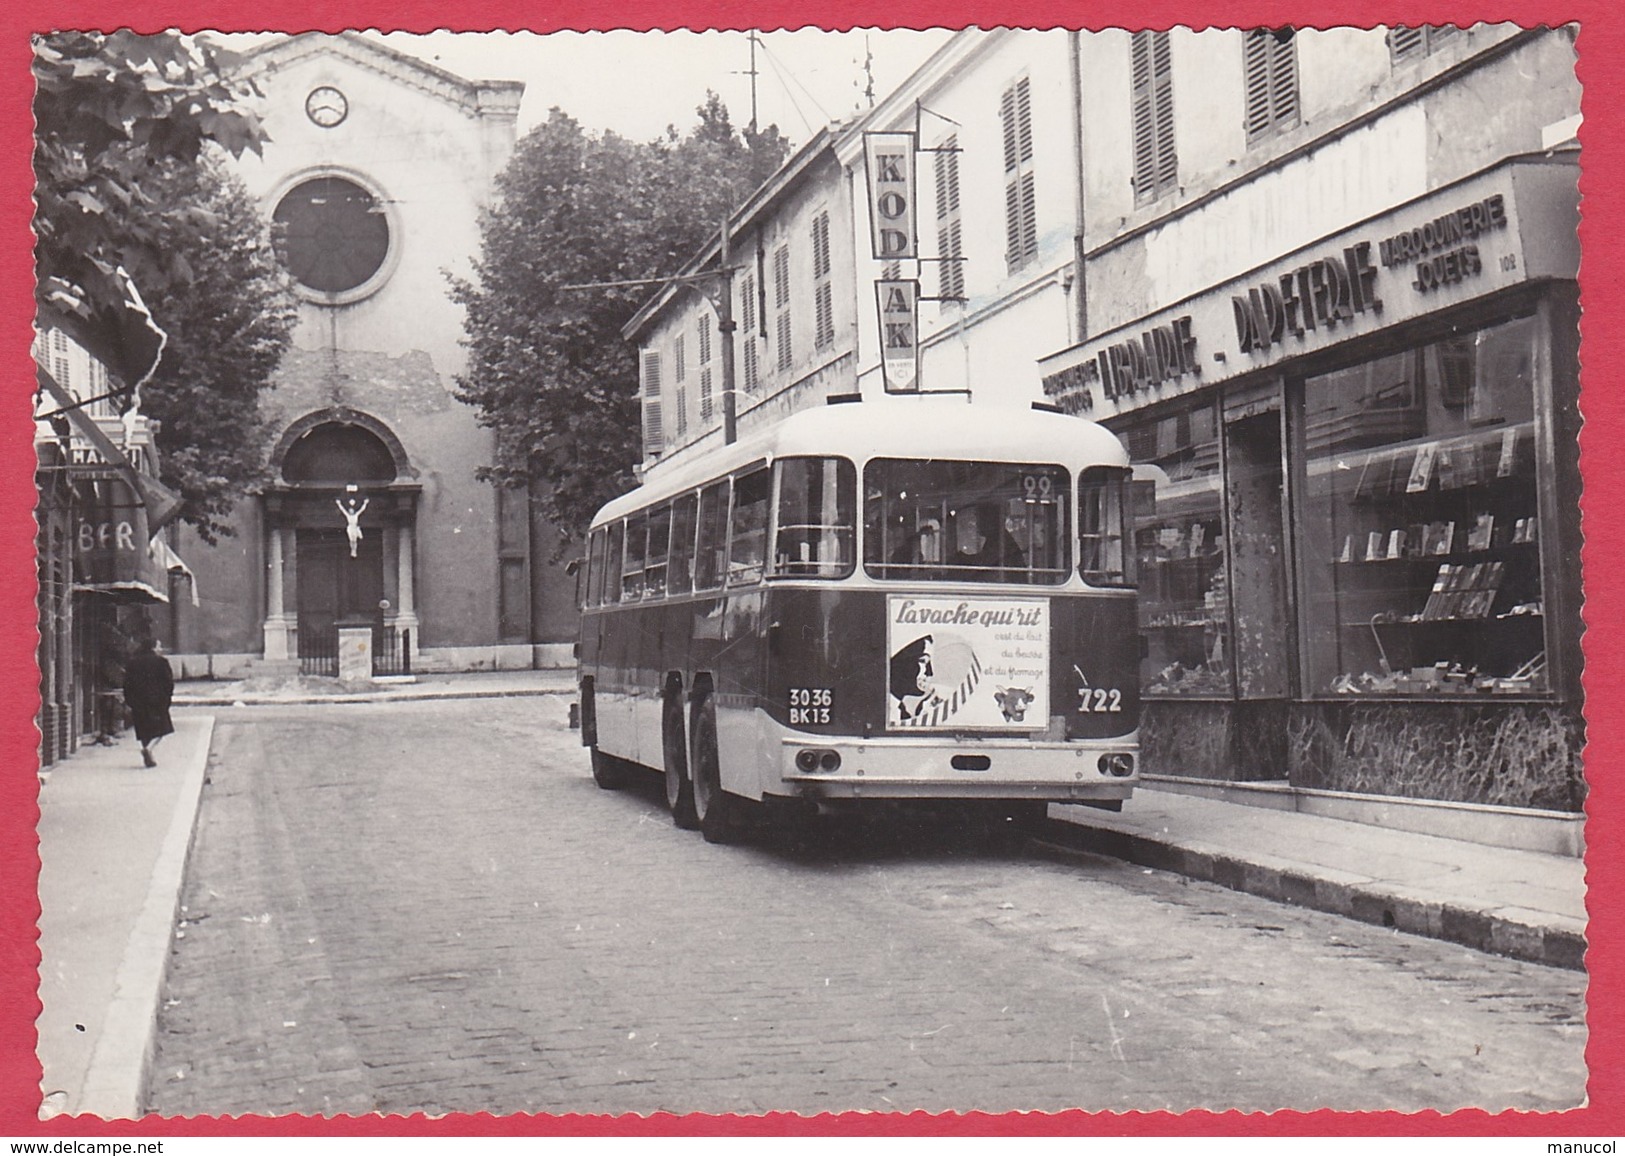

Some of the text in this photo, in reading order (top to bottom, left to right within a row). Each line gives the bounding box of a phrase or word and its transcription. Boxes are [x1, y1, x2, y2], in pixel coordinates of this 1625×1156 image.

[1379, 194, 1507, 267] MAROQUINERIE
[1412, 245, 1482, 292] JOUETS
[1231, 240, 1384, 354] PAPETERIE
[979, 608, 1014, 628] qui
[1016, 607, 1042, 626] rit
[1001, 649, 1014, 659] du
[984, 666, 994, 676] et
[995, 666, 1007, 676] du
[1078, 688, 1122, 712] 722
